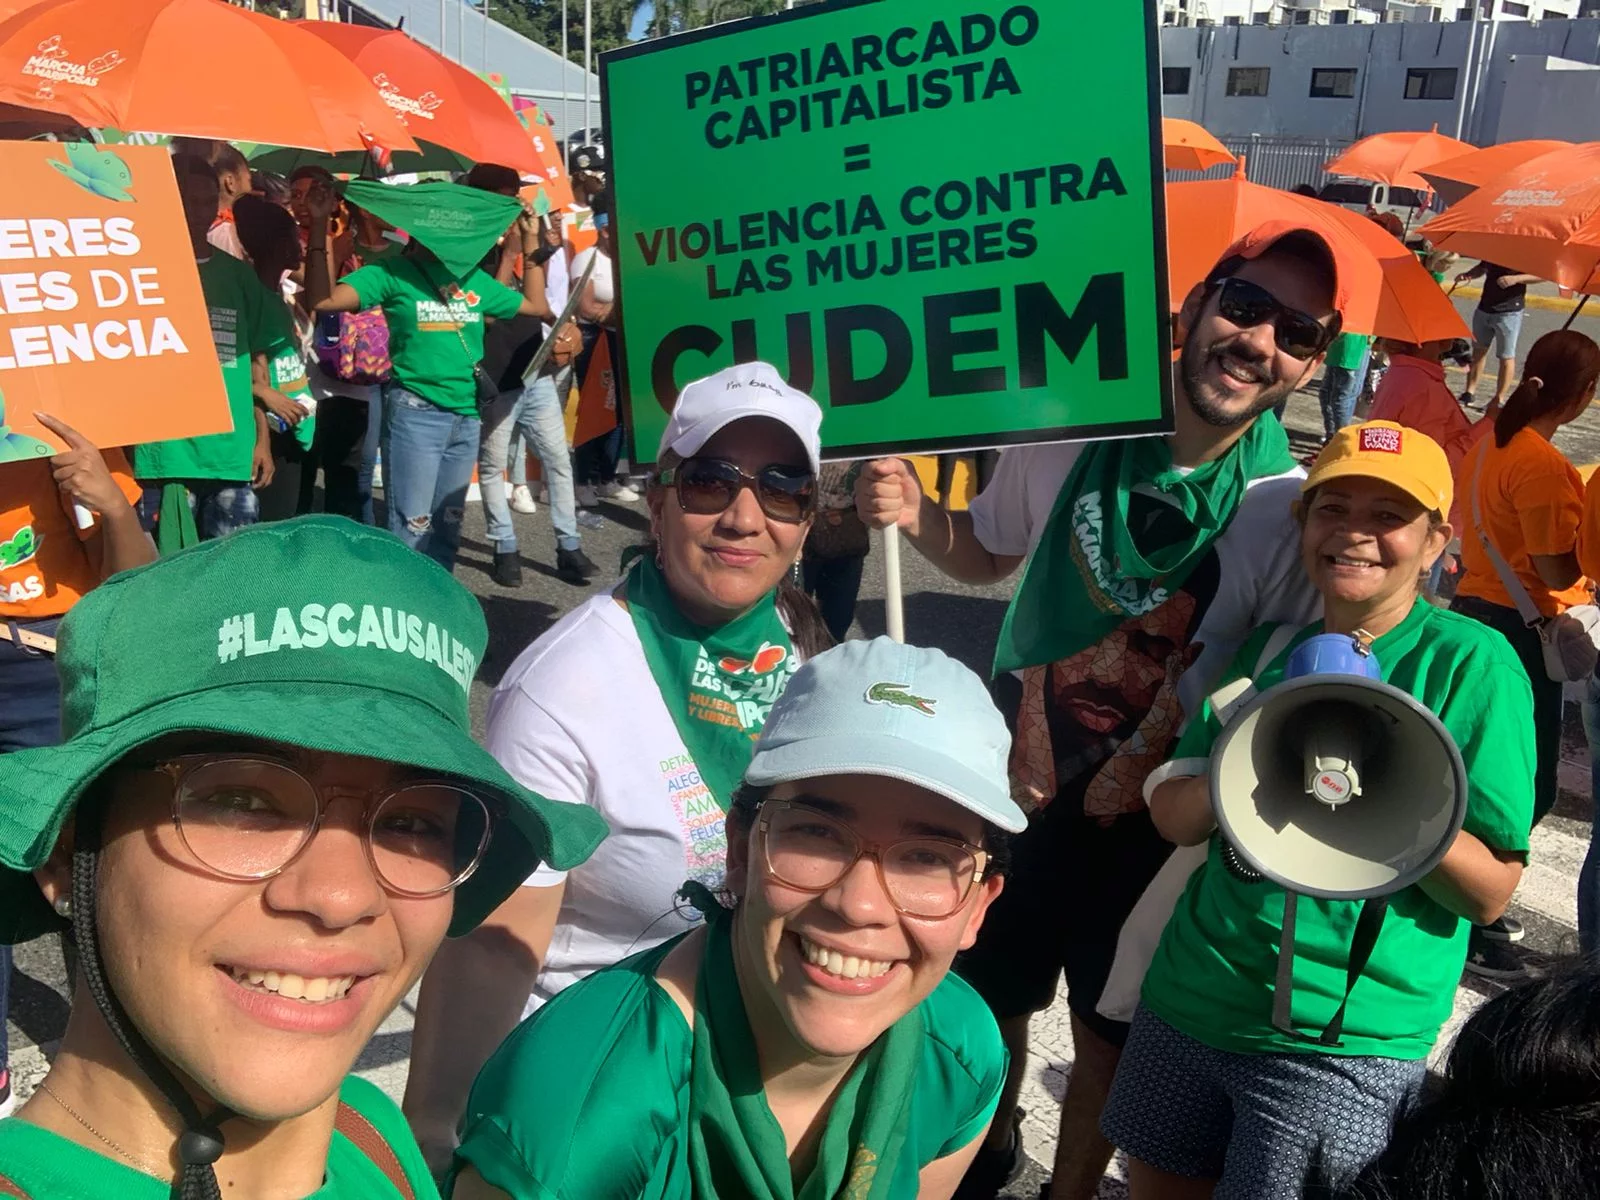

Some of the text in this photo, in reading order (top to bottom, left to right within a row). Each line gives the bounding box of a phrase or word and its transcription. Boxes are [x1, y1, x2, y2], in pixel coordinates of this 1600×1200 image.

[27, 56, 86, 76] MARCHA
[685, 5, 1039, 109] PATRIARCADO
[704, 57, 1022, 149] CAPITALISTA
[635, 156, 1127, 266] VIOLENCIA CONTRA
[0, 217, 141, 259] ERES
[706, 219, 1038, 300] LAS MUJERES
[0, 267, 165, 314] ES DE
[650, 272, 1129, 418] CUDEM
[1365, 442, 1398, 451] WALK
[692, 672, 722, 692] LAS
[695, 658, 716, 676] DE
[689, 692, 737, 714] MUJERE
